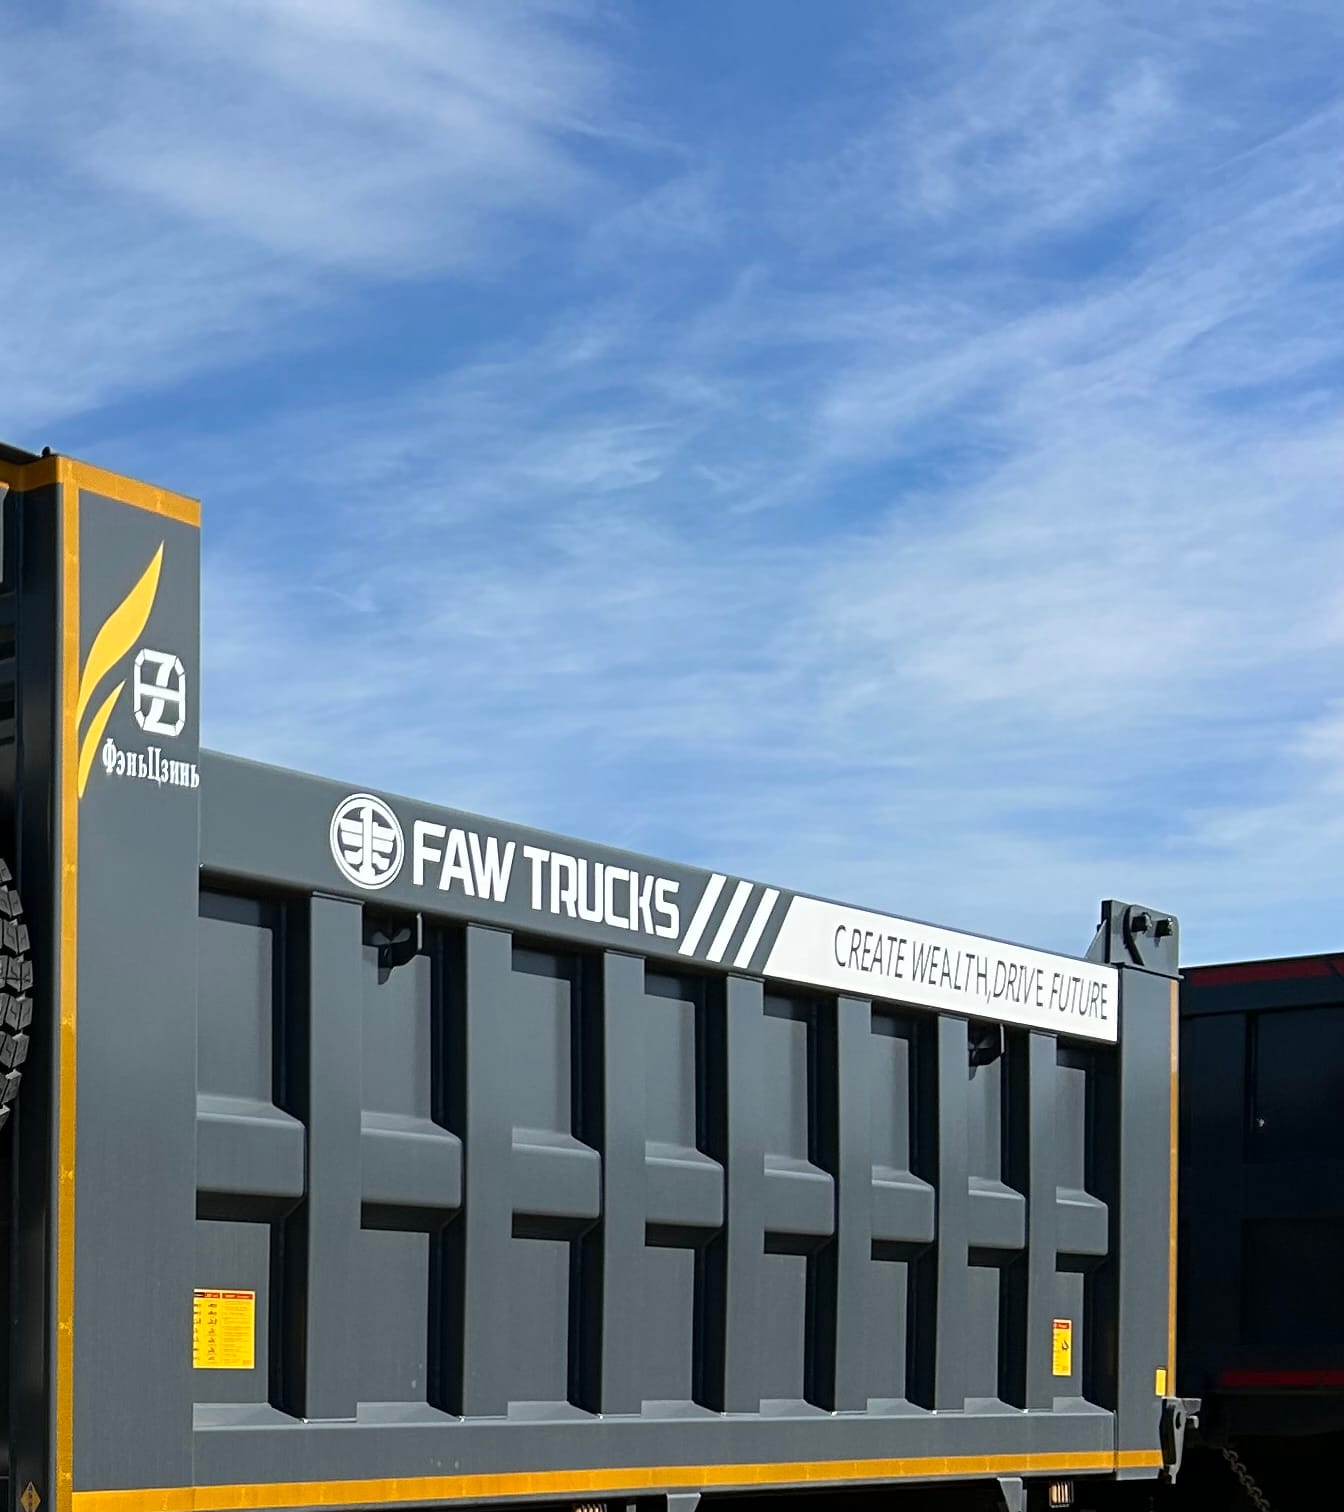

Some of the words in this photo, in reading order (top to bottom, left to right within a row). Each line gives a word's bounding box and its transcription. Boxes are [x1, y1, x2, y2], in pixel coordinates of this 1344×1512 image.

[413, 820, 516, 903] FAW
[523, 845, 681, 940] TRUCKS
[834, 924, 908, 979] CREATE
[1048, 972, 1109, 1021] FUTURE
